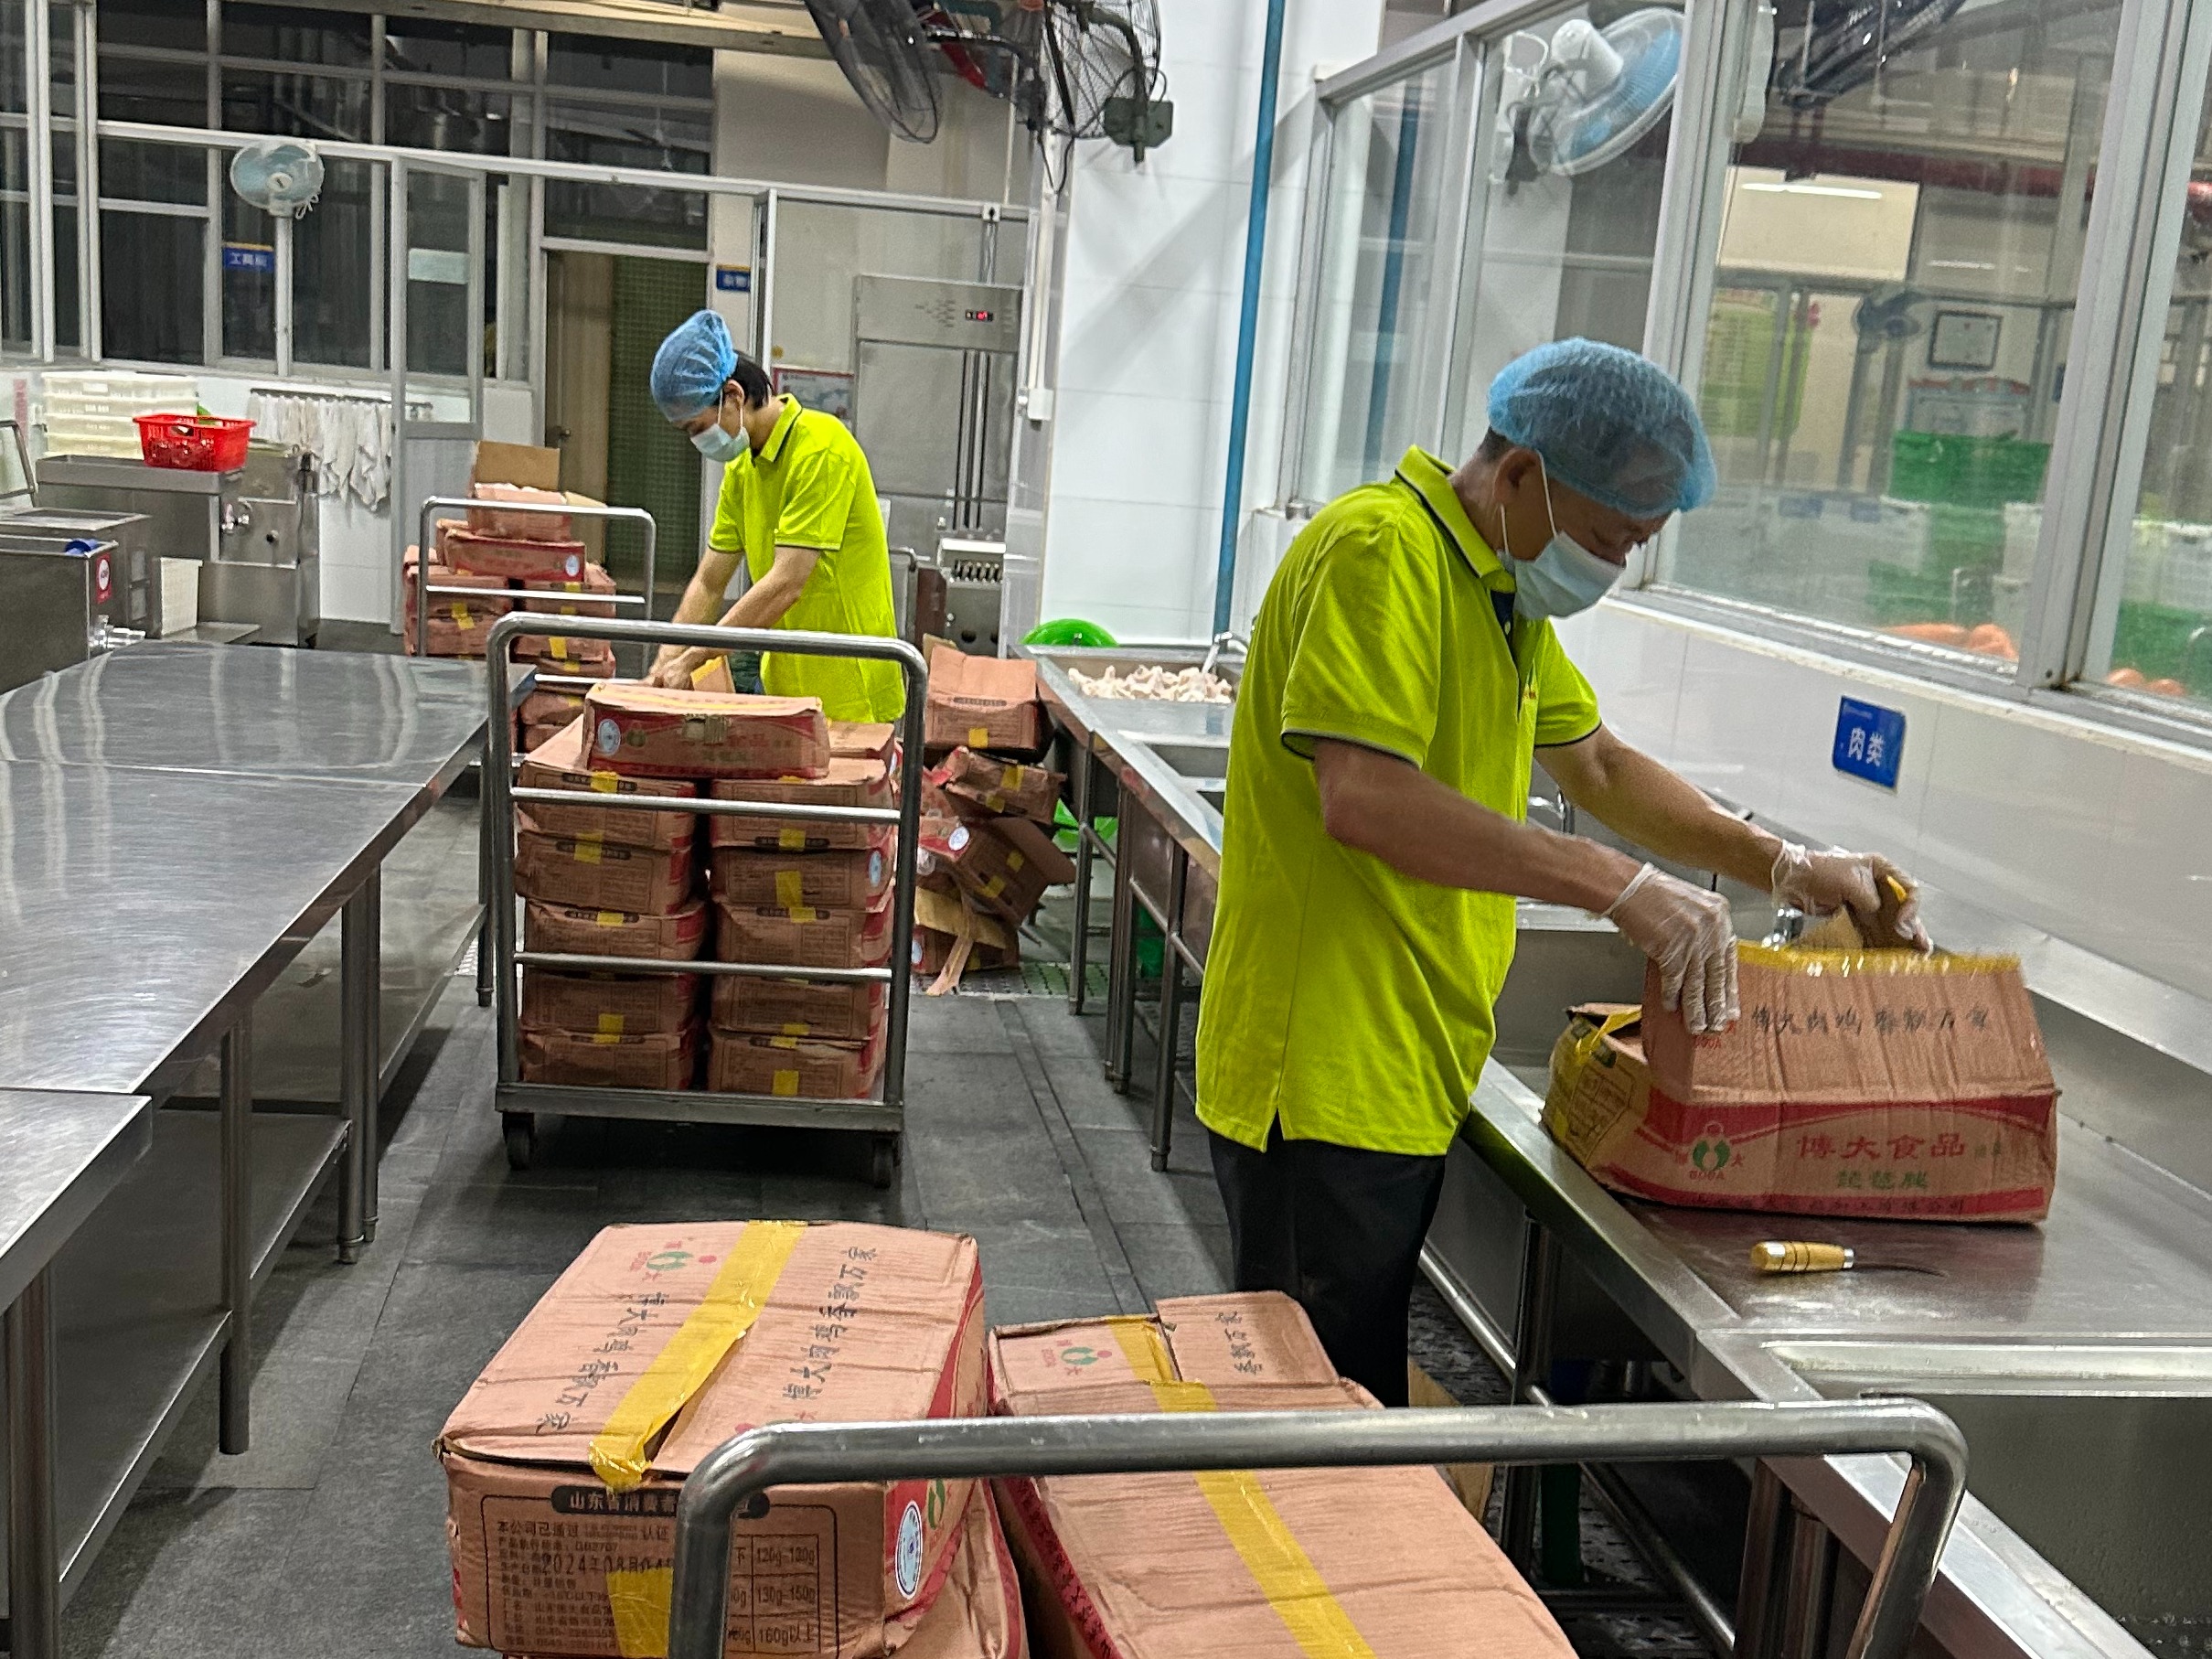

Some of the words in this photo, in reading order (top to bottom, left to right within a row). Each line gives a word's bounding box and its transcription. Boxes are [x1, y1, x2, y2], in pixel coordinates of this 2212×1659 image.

[1847, 727, 1885, 766] 肉类
[1797, 1133, 1965, 1161] 博大食品
